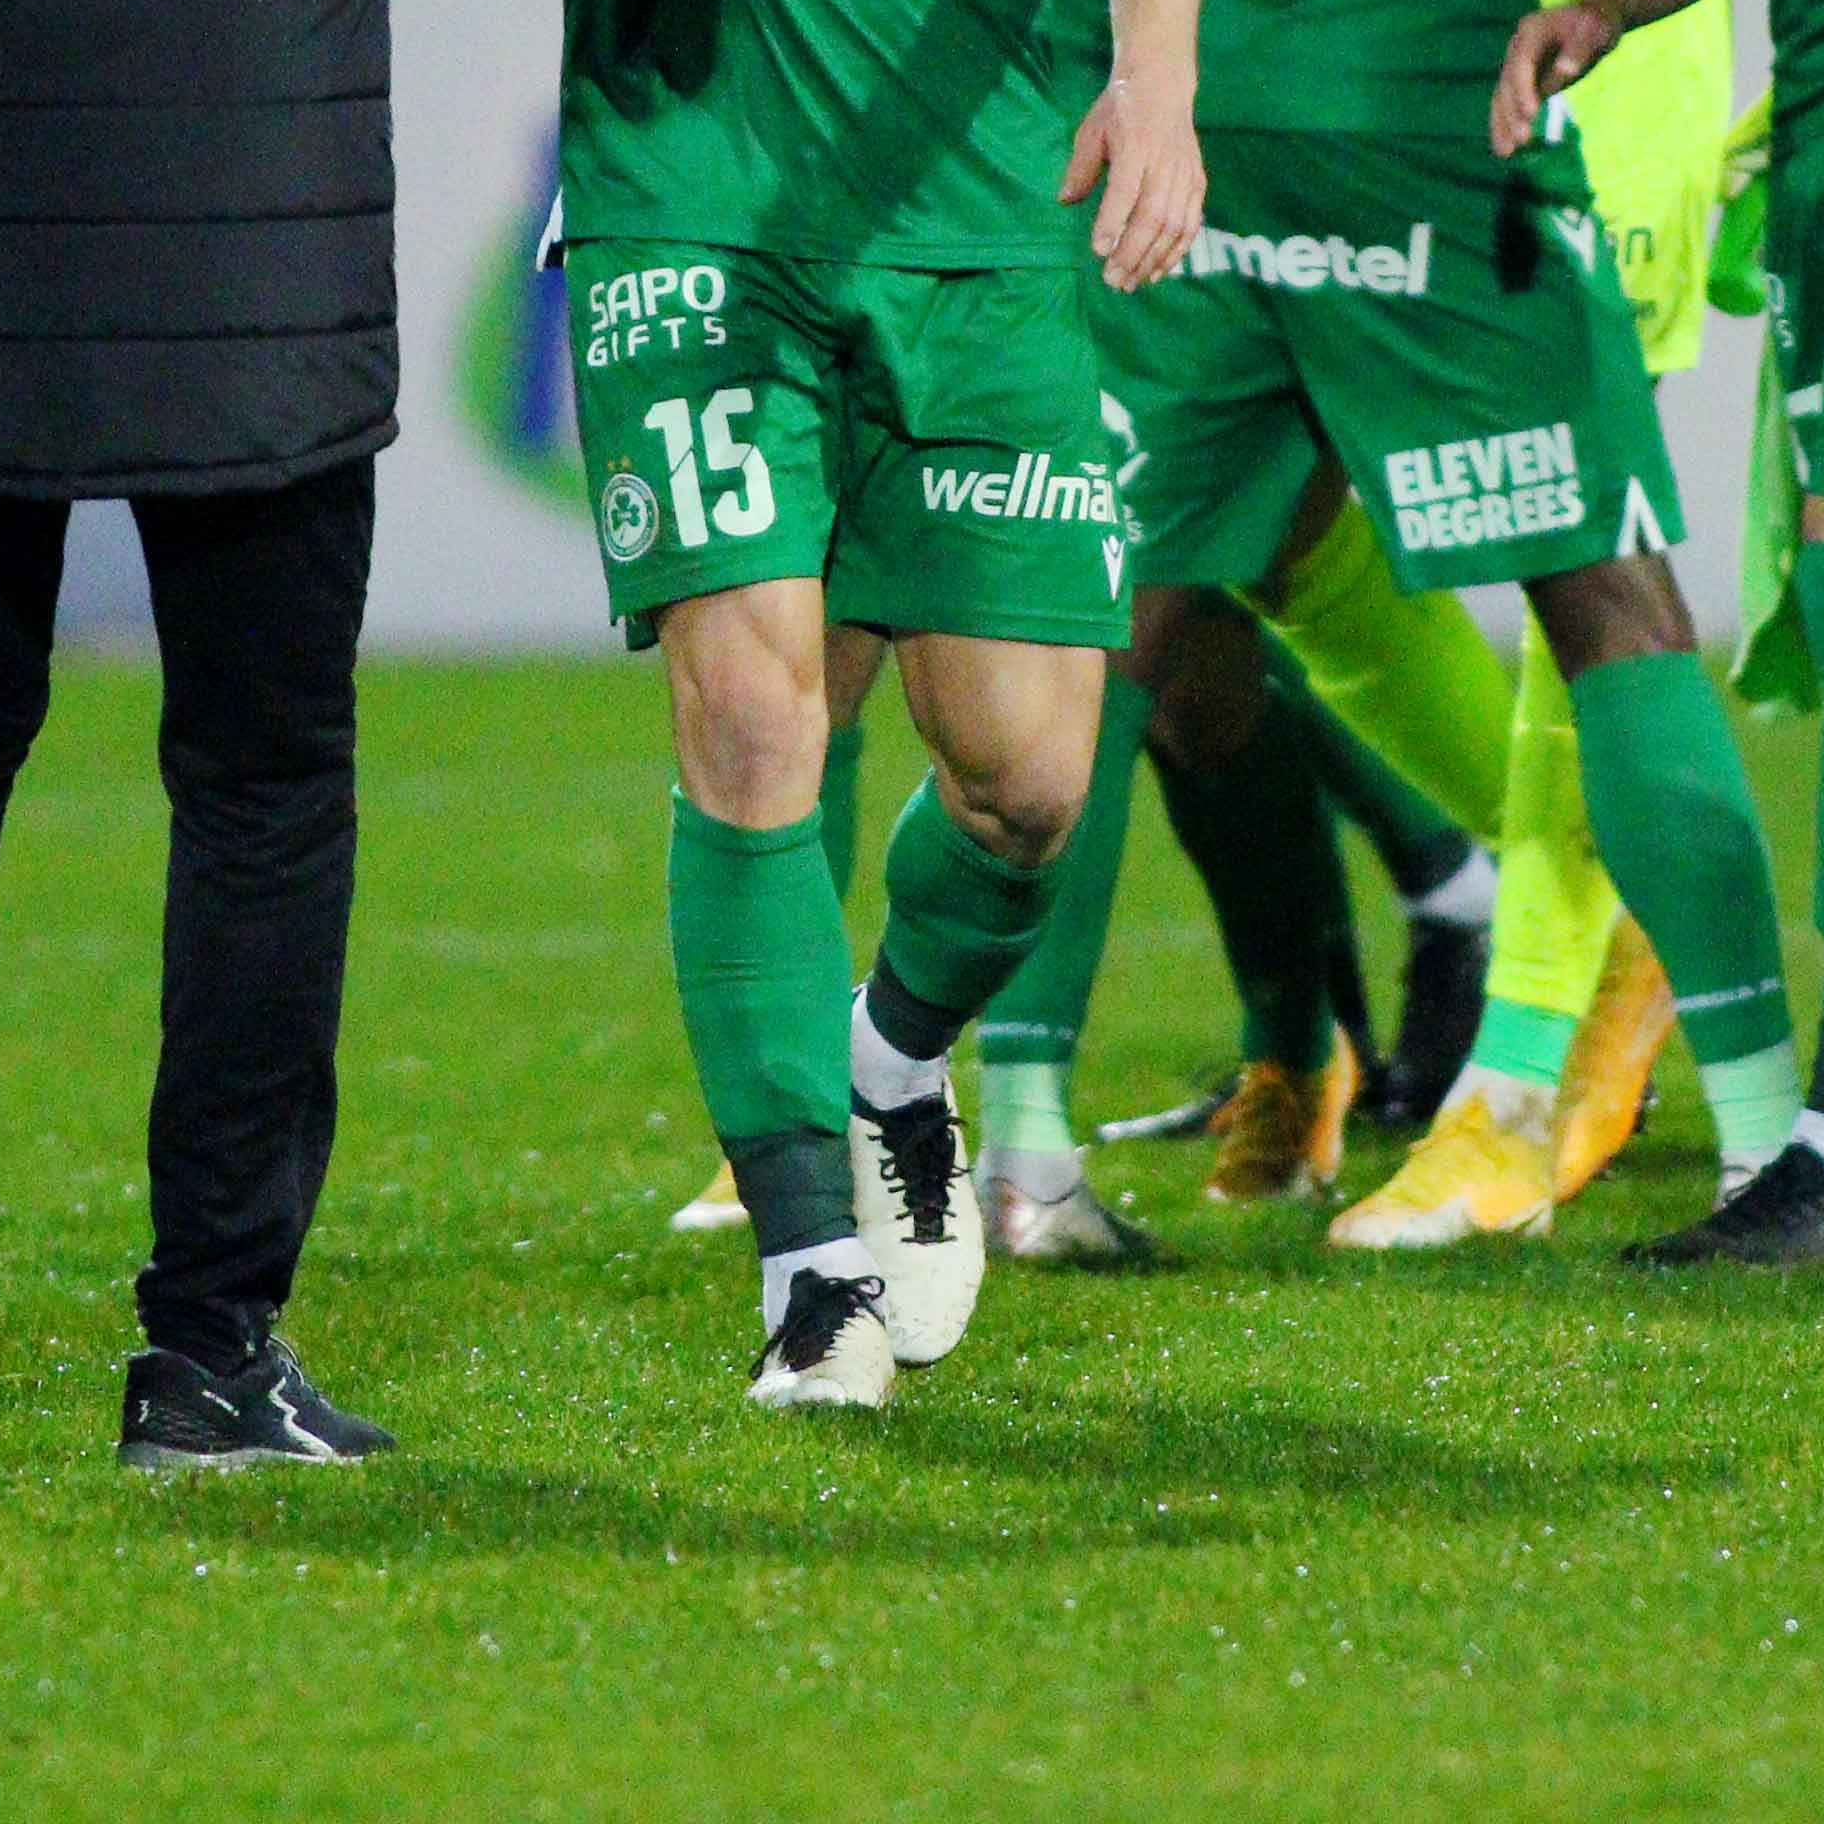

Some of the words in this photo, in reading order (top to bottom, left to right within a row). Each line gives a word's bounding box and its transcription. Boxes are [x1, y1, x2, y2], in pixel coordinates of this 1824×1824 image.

[589, 264, 727, 333] SAPO
[586, 315, 728, 367] GIFTS
[644, 387, 776, 547] 15
[921, 452, 1119, 524] wellma
[1384, 422, 1576, 507] ELEVEN
[1395, 478, 1586, 551] DEGREES
